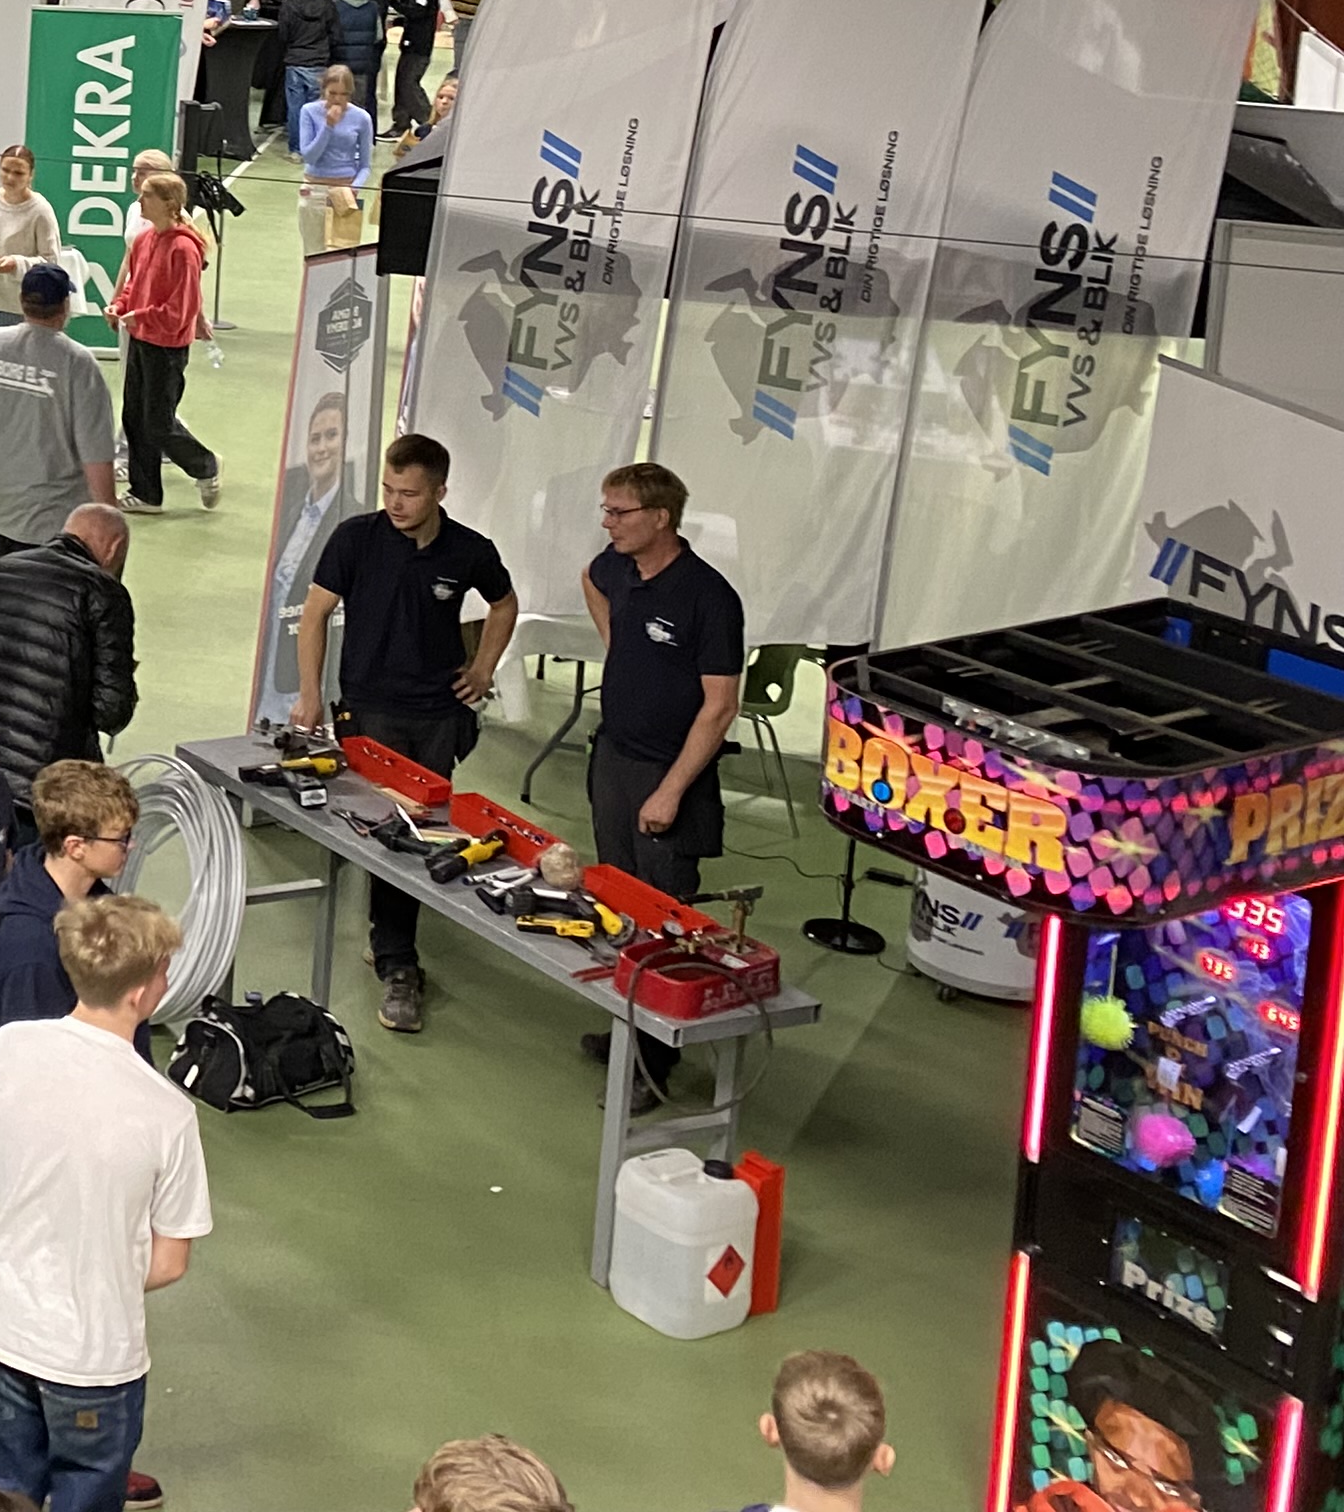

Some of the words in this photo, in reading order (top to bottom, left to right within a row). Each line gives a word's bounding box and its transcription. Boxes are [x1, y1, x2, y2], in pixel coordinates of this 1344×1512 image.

[67, 34, 136, 236] DEKRA
[878, 130, 900, 202] LØSNING
[602, 252, 616, 285] DIN
[618, 118, 639, 188] LØSNING
[1140, 156, 1164, 230] LØSNING
[506, 176, 575, 371] FYNS
[824, 202, 859, 280] BLIK
[866, 206, 887, 269] RIGTIGE
[1083, 229, 1119, 311] BLIK
[1127, 233, 1150, 304] RIGTIGE
[550, 300, 580, 371] VVS
[565, 270, 586, 292] &
[757, 192, 831, 392] FYNS
[820, 288, 844, 313] &
[862, 274, 874, 304] DIN
[1010, 220, 1090, 427] FYNS
[1122, 305, 1137, 334] DIN
[805, 322, 836, 392] VVS
[1078, 320, 1103, 346] &
[1062, 354, 1096, 428] VVS
[825, 716, 1067, 874] BOXER
[921, 893, 961, 926] NS
[1122, 1260, 1218, 1336] Prize
